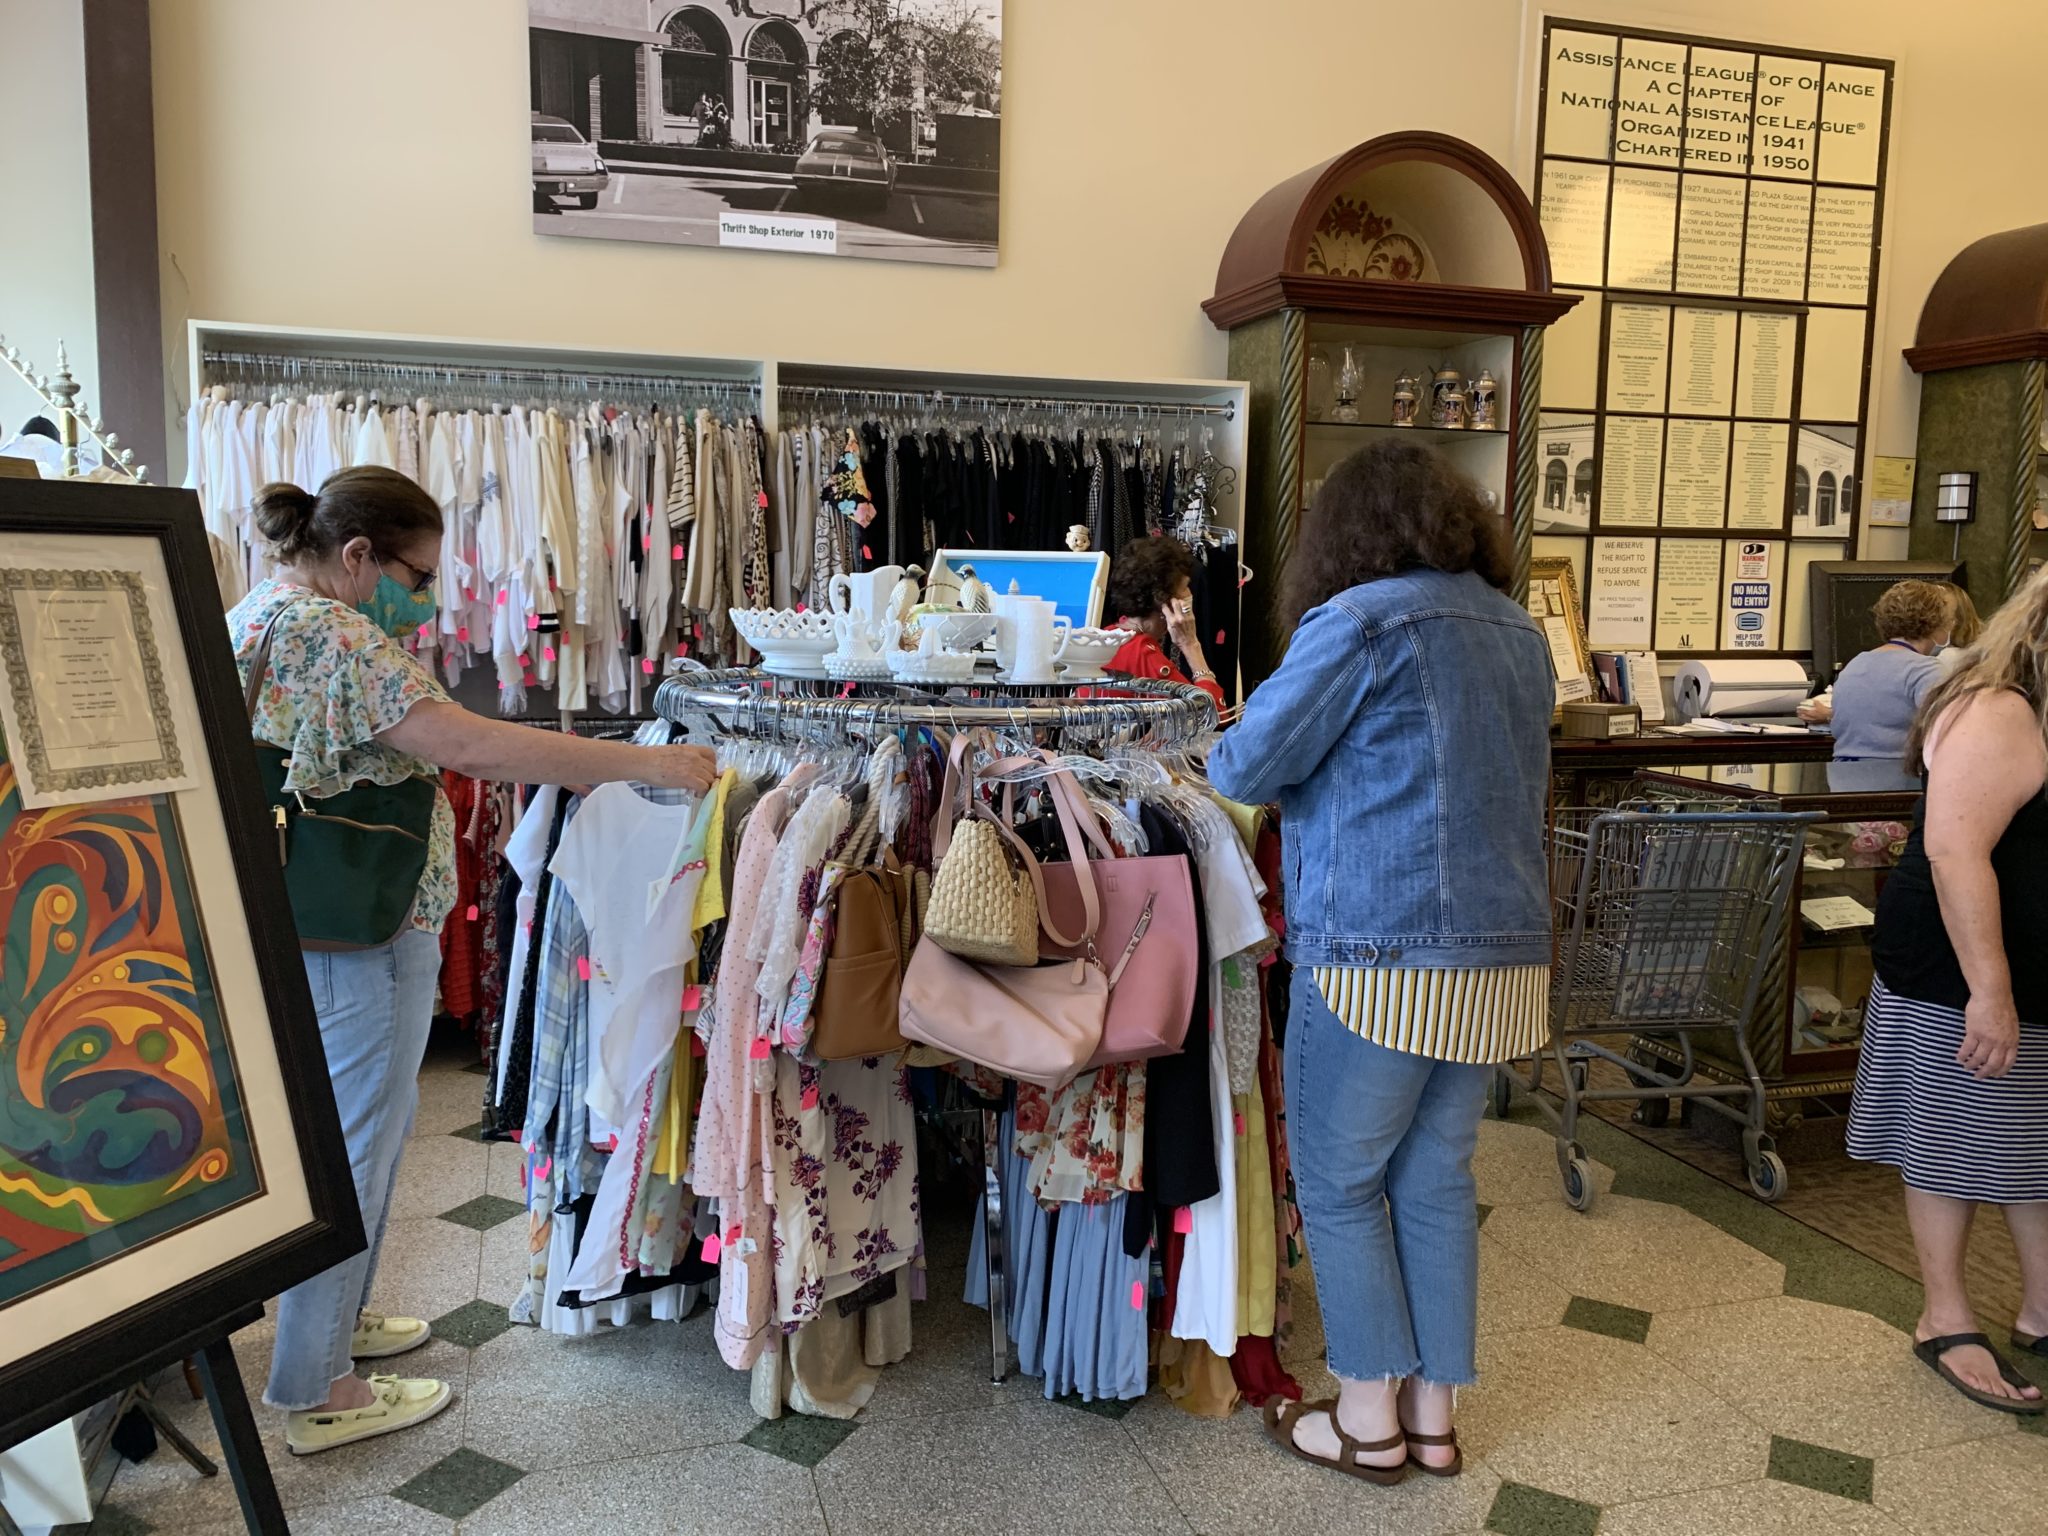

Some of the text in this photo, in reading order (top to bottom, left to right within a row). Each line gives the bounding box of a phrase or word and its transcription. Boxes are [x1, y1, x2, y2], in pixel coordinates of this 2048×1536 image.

[1646, 80, 1661, 94] A
[1763, 134, 1805, 150] 1941
[1763, 155, 1810, 171] 1950
[721, 223, 834, 240] Thrift Shop Exterior 1970
[1739, 222, 1763, 230] TRIFT
[1792, 226, 1825, 235] OPERTED
[1604, 541, 1644, 549] WE RESERVE
[1616, 554, 1635, 562] RIGHT
[1734, 585, 1768, 595] NO MASK
[1732, 597, 1769, 606] NO ENTRY
